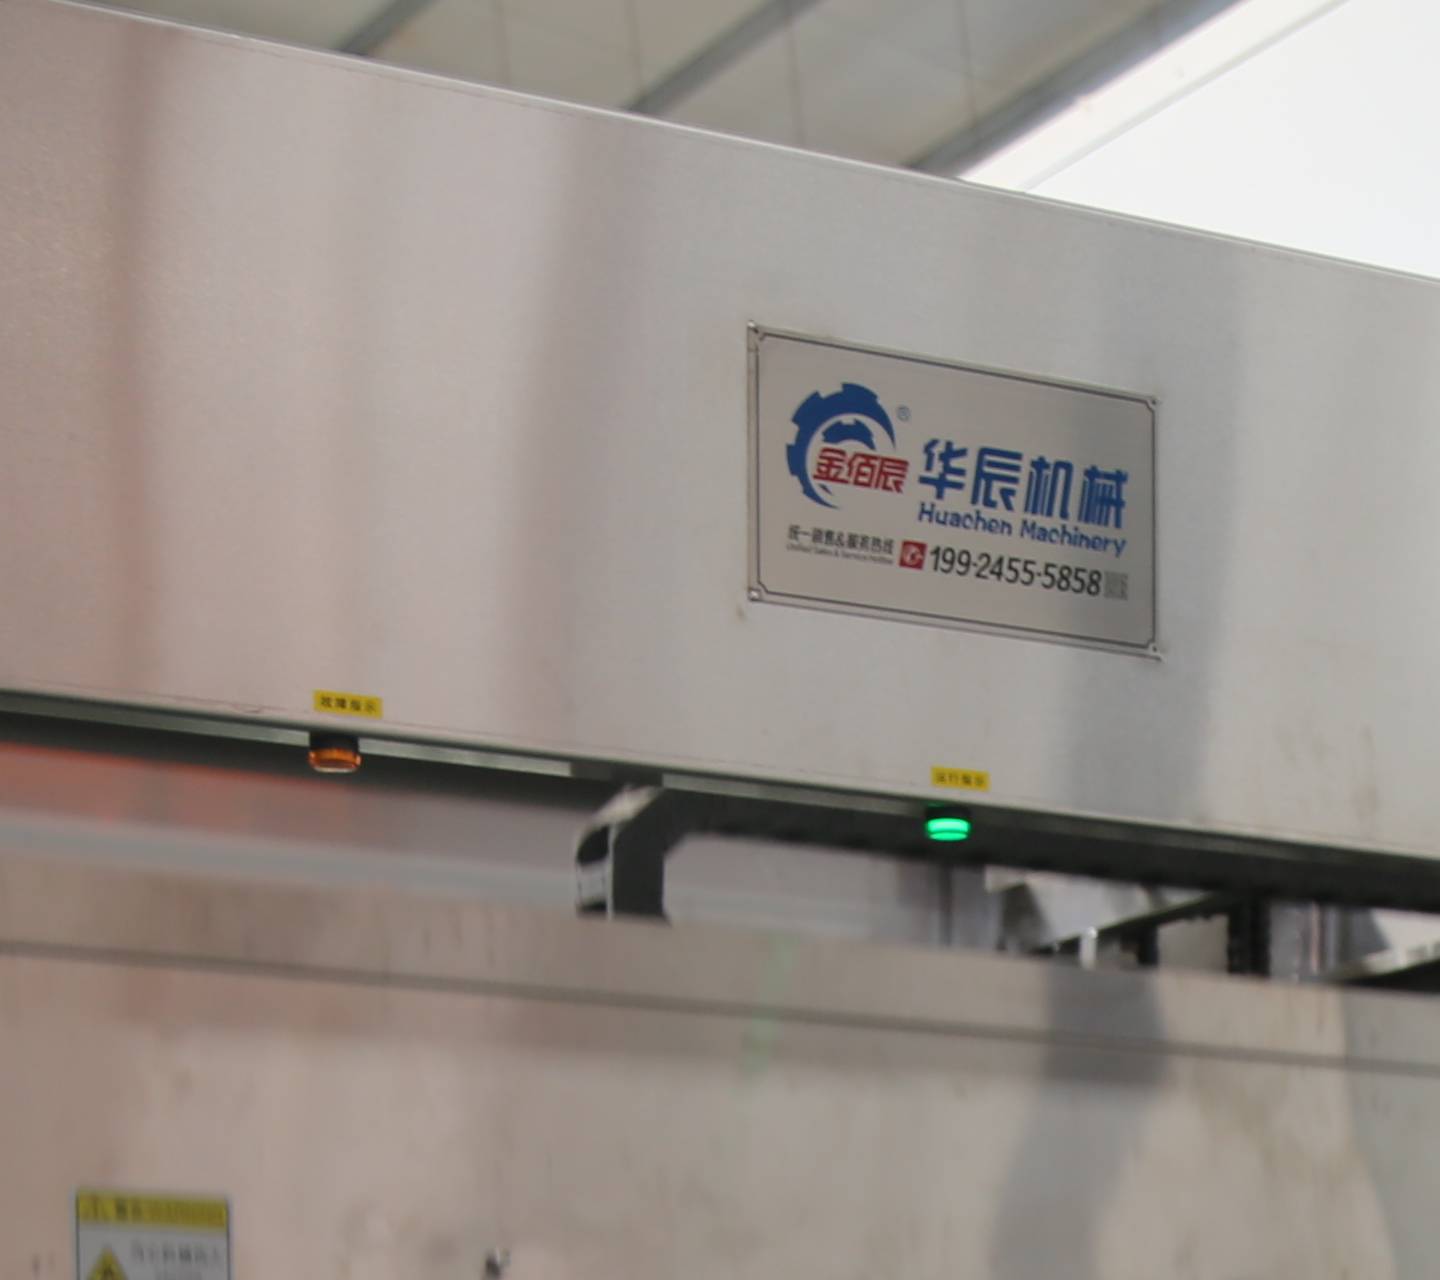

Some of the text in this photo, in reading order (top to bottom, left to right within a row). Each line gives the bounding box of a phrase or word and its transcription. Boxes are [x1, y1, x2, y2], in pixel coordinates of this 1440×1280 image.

[813, 447, 909, 494] 金佰辰
[918, 438, 1129, 529] 华辰机械
[918, 502, 1127, 558] Huachen Machinery
